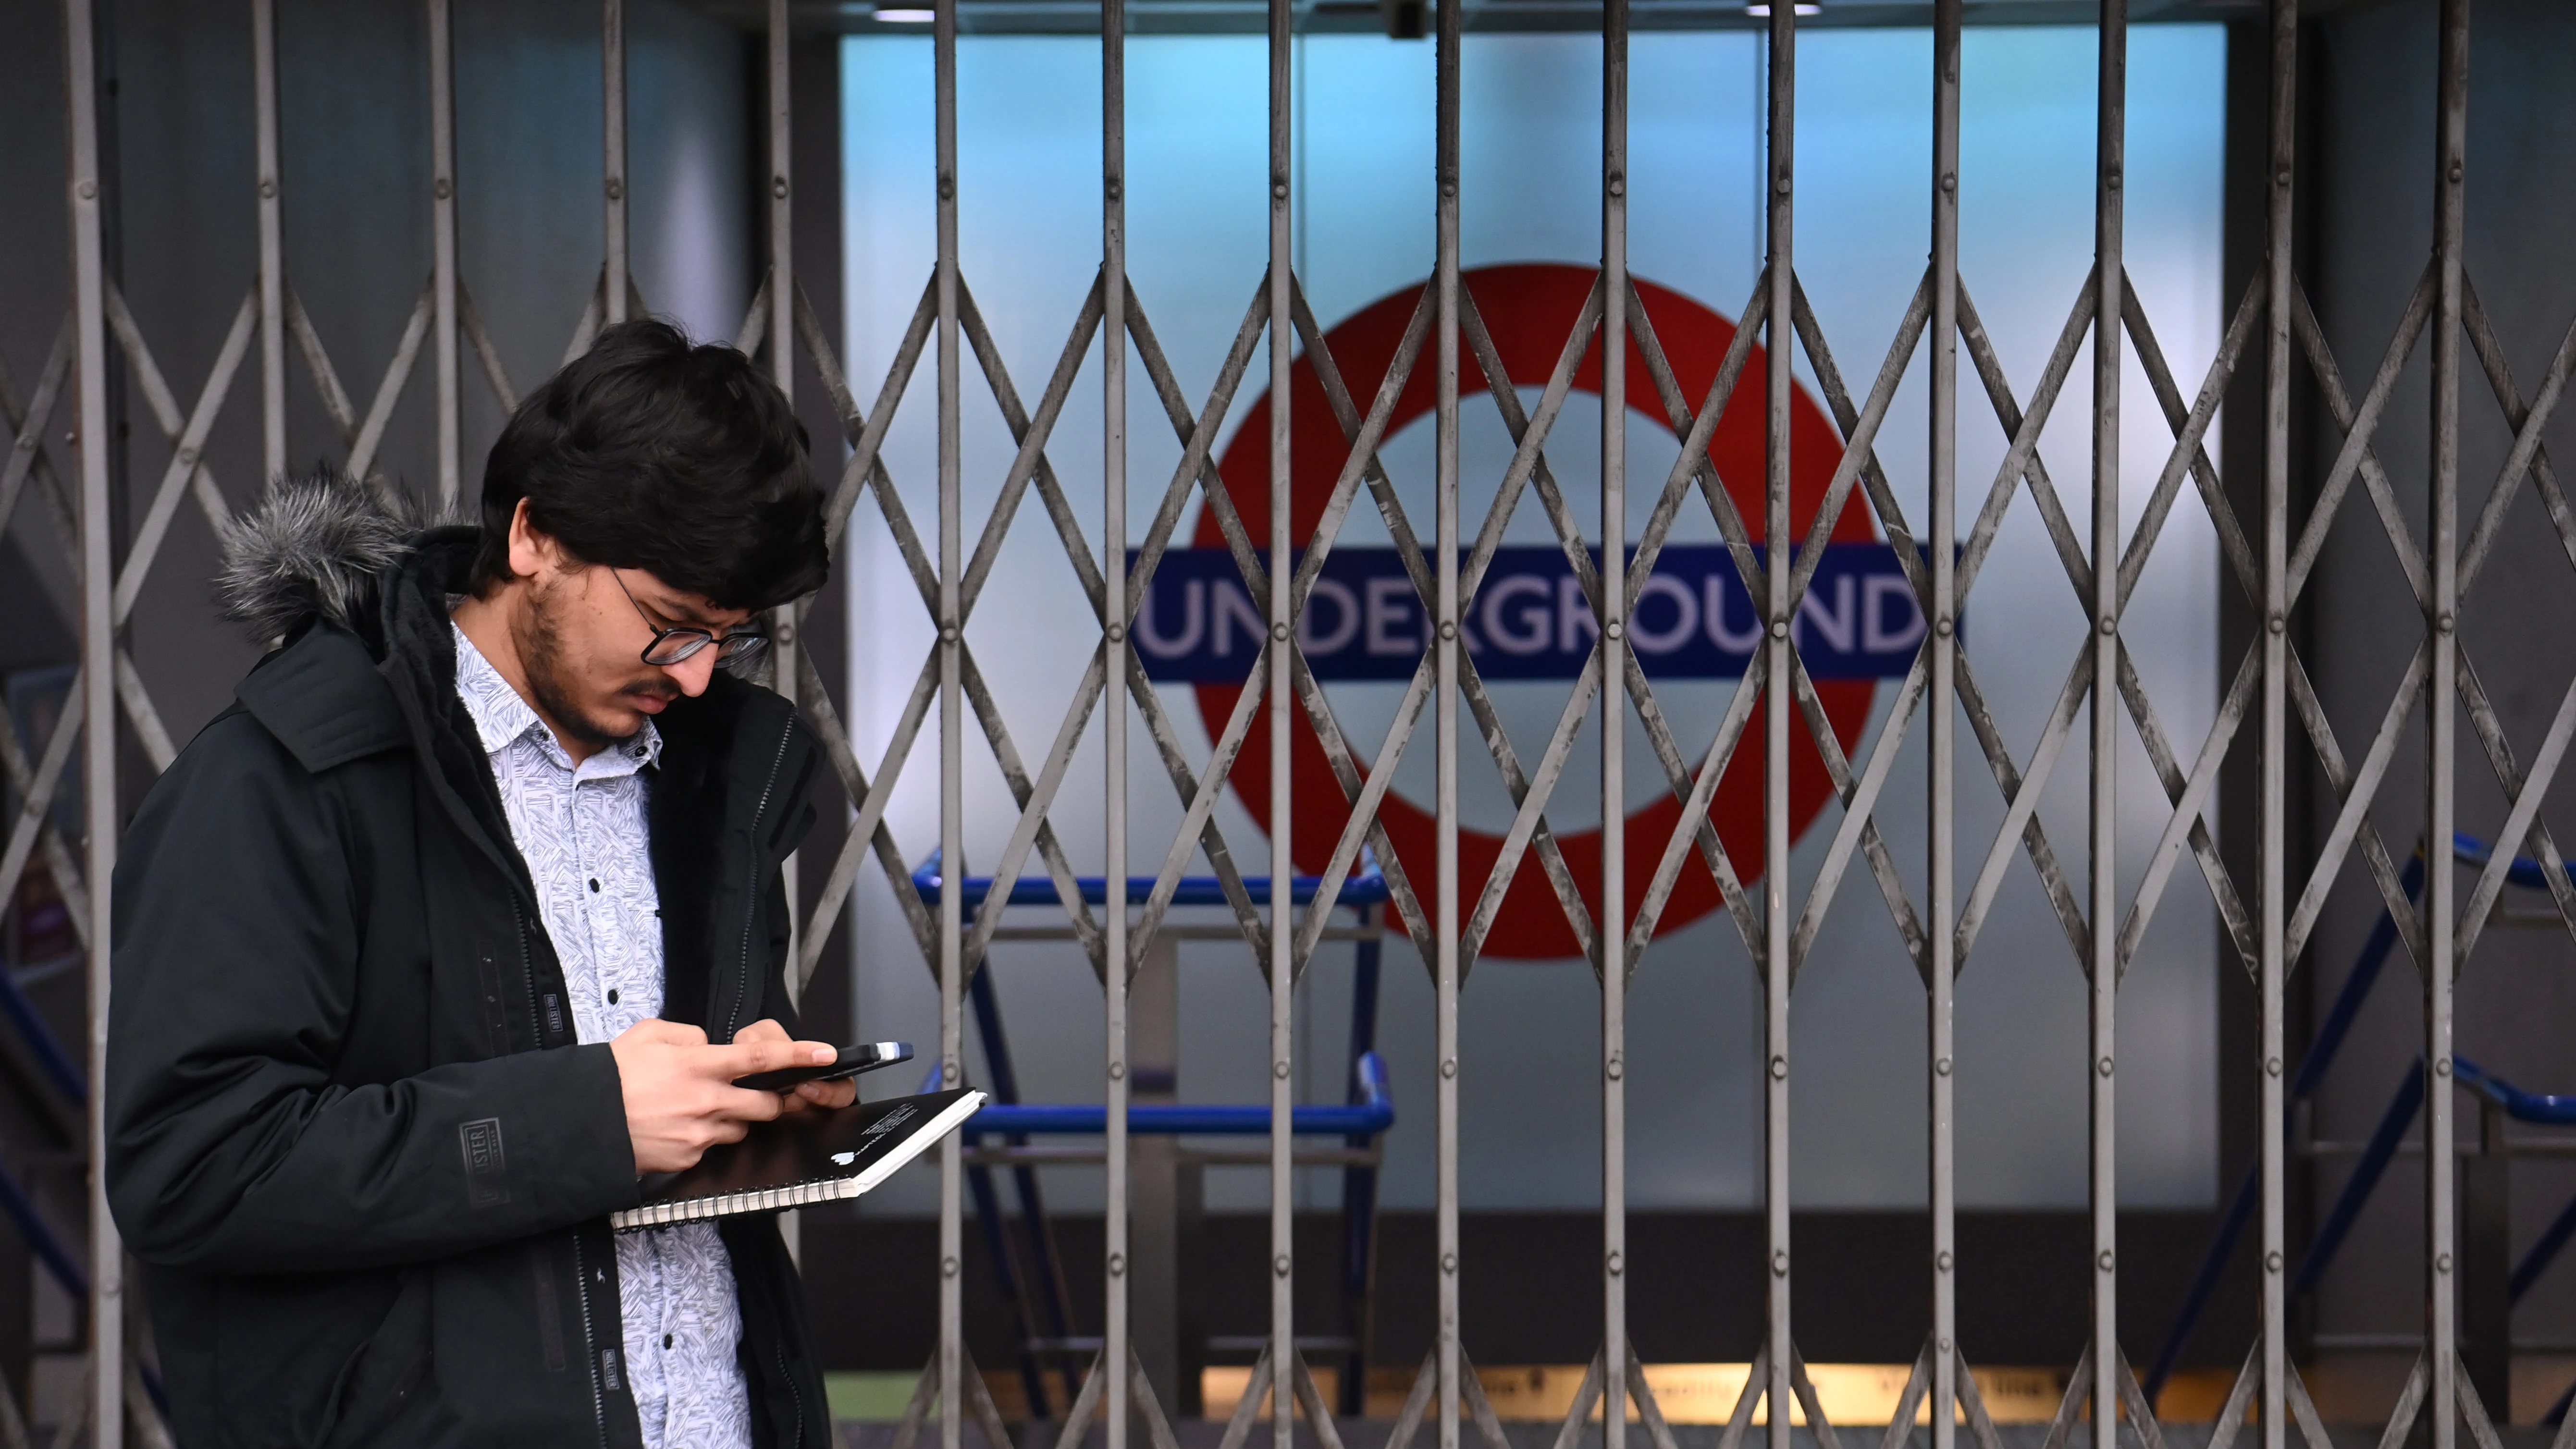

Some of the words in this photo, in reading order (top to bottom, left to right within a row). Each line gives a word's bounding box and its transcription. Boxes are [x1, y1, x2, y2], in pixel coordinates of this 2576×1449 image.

[546, 996, 560, 1030] HOLLISTER
[470, 1130, 494, 1198] HLISTER
[605, 1351, 617, 1387] HOLLISTER
